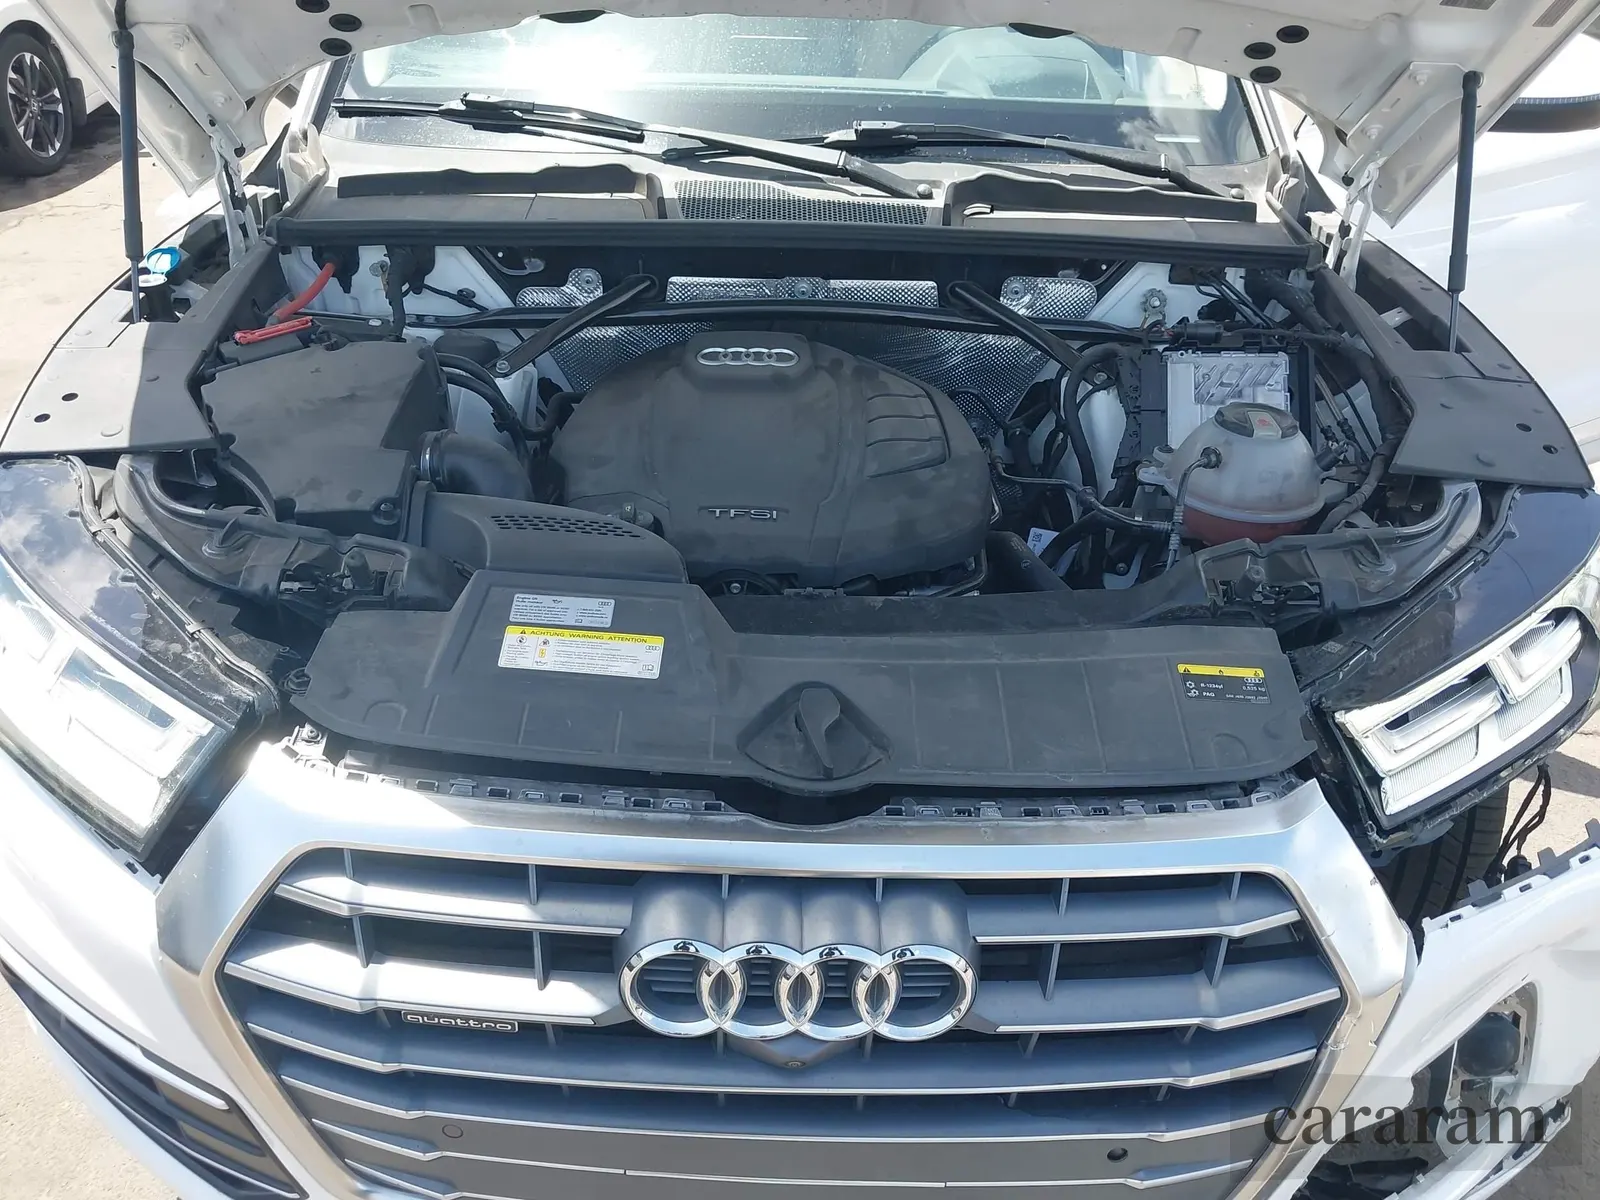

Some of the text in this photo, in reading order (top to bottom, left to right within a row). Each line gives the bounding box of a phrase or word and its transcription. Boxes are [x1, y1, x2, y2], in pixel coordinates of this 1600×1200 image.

[708, 508, 777, 519] TFSI
[529, 630, 565, 638] ACHTUNG
[608, 635, 648, 644] ATTENTION
[407, 1014, 512, 1030] quattro
